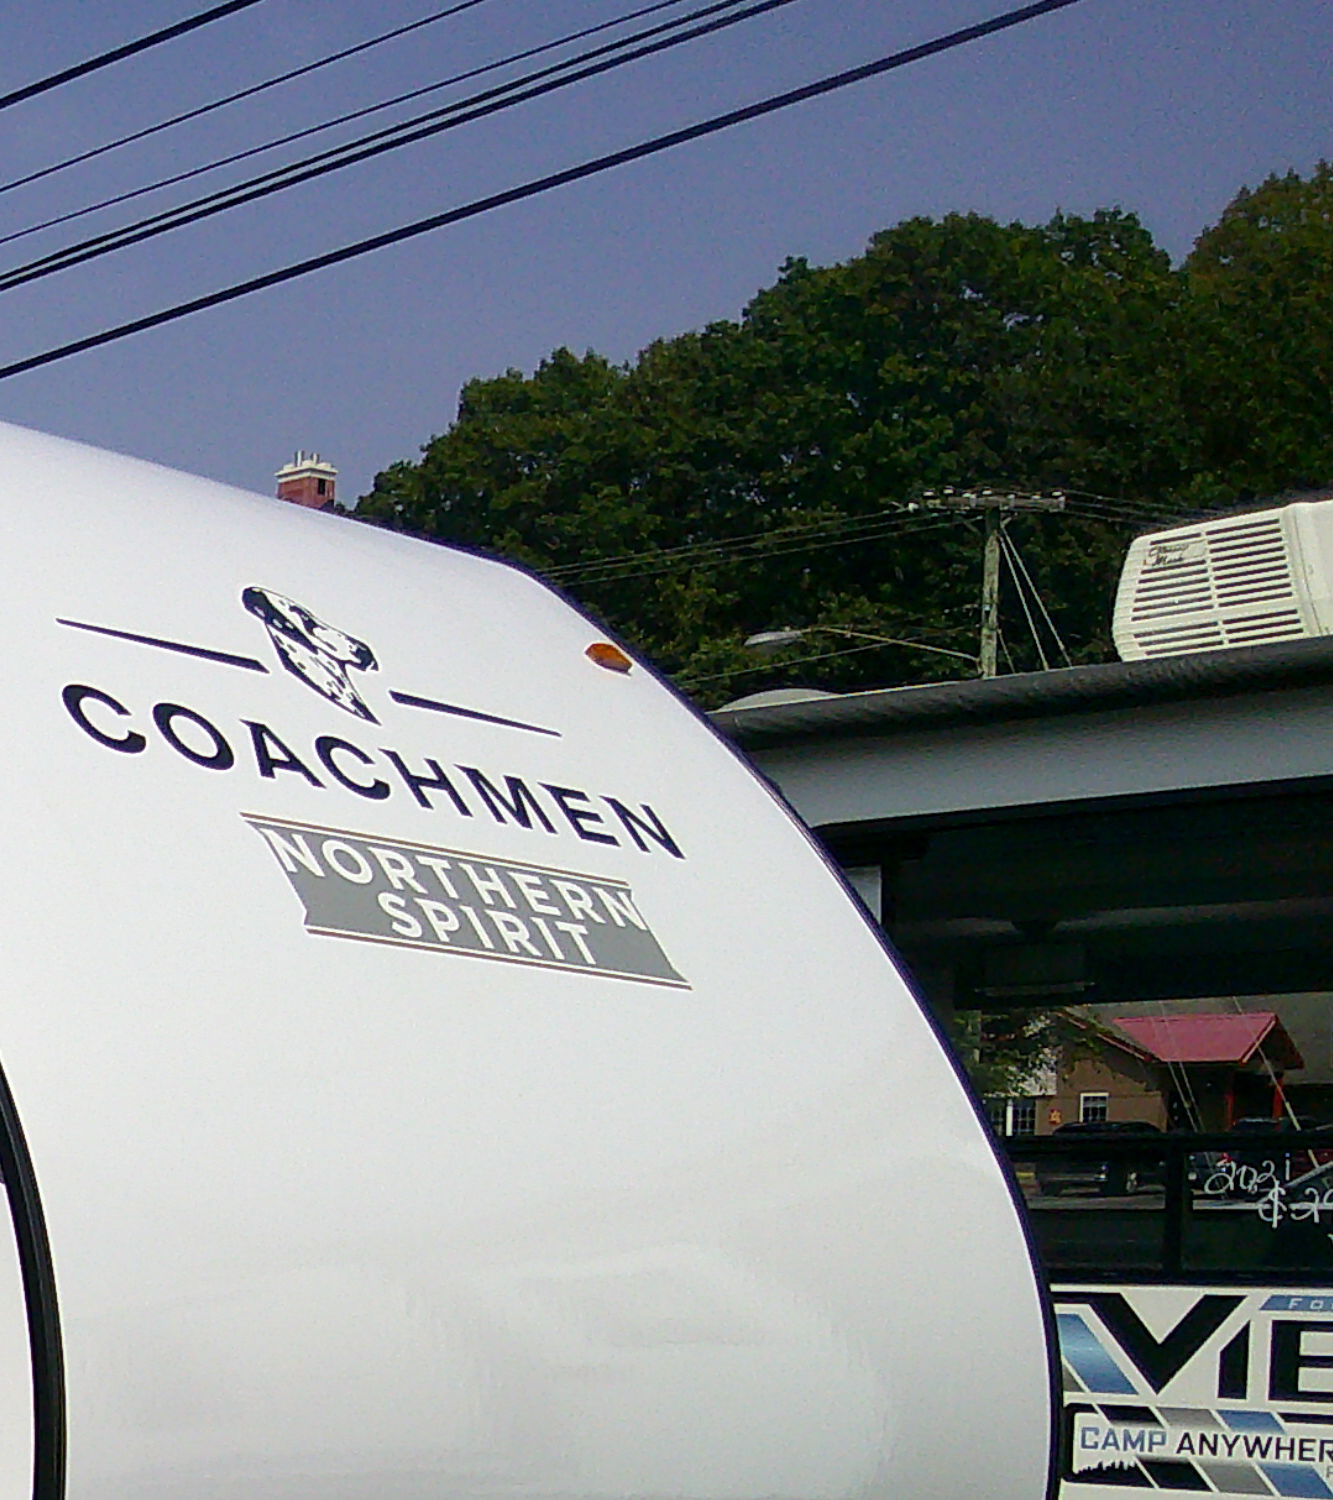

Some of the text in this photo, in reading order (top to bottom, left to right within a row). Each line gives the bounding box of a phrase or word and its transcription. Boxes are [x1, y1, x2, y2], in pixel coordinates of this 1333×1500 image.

[61, 683, 687, 861] COACHMEN
[261, 825, 648, 933] NORTHERN
[376, 890, 598, 966] SPIRIT
[1081, 1426, 1167, 1453] CAMP
